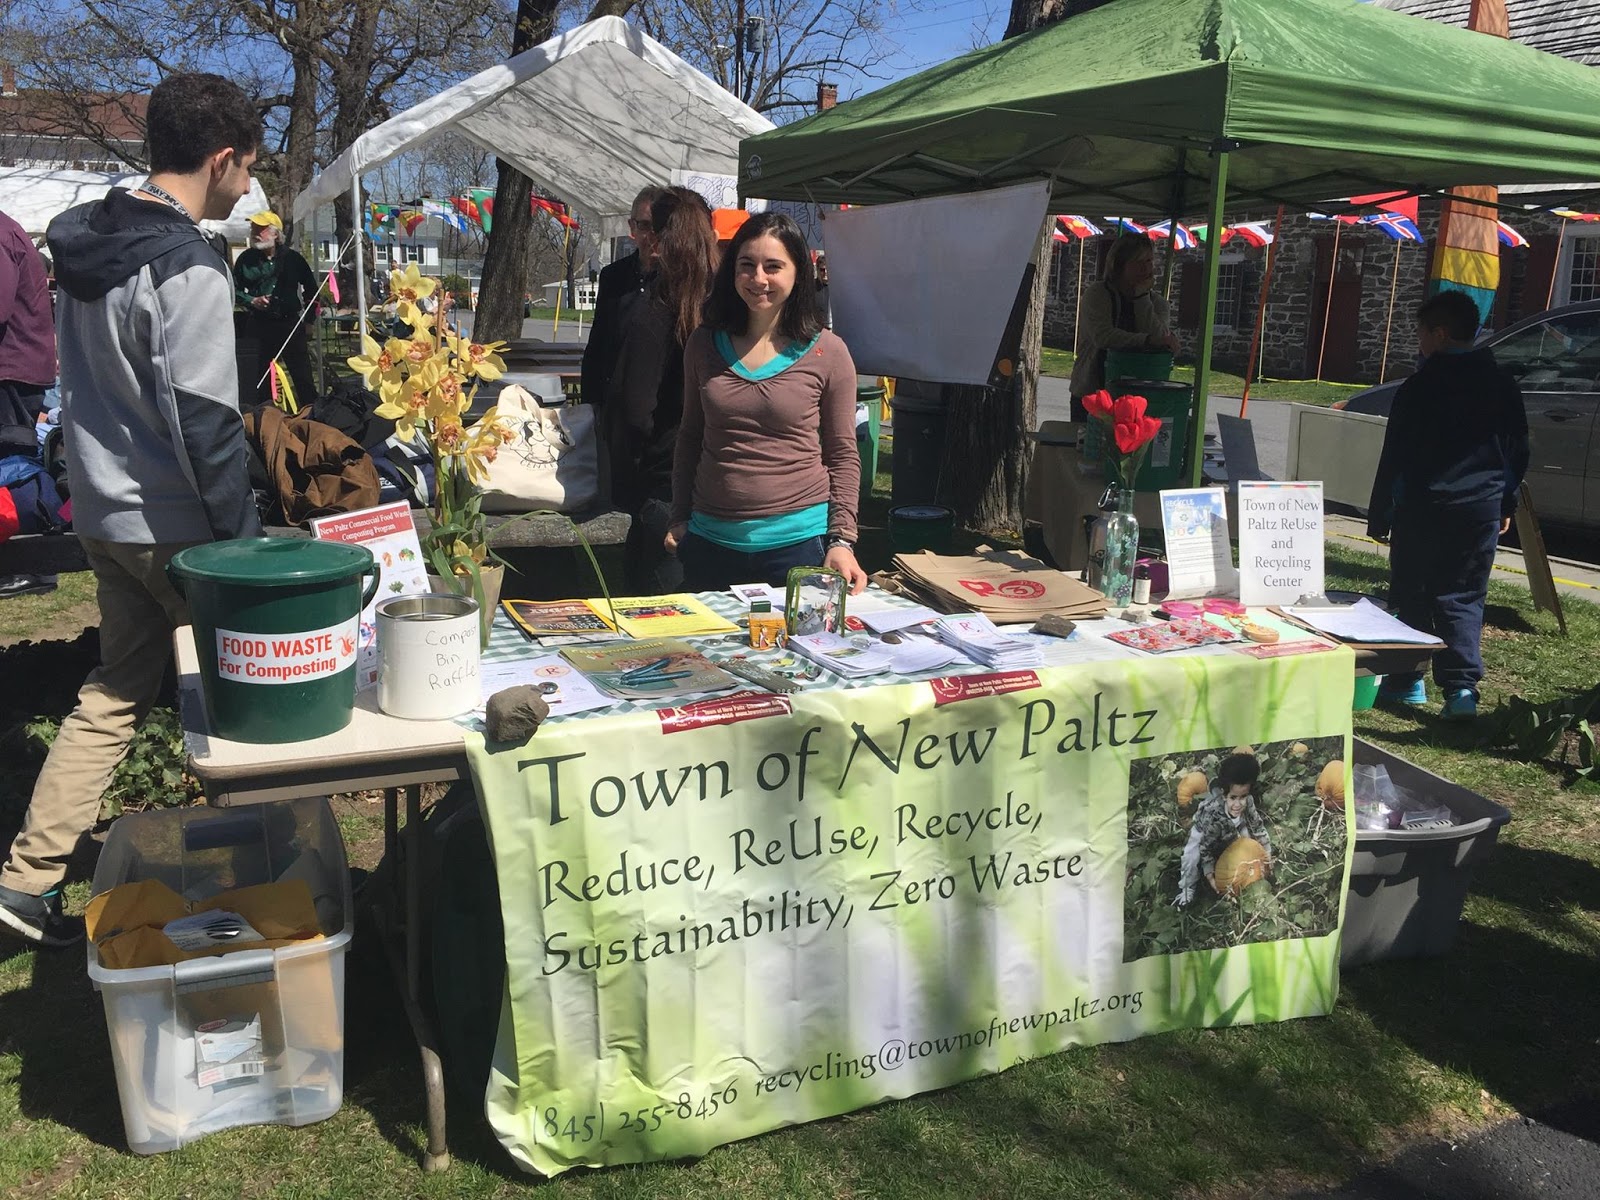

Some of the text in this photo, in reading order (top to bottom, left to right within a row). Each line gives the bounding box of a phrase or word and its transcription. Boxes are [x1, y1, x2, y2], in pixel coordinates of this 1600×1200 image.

[275, 372, 284, 404] CAU
[1243, 498, 1320, 512] Town of New
[320, 527, 336, 537] New
[335, 523, 349, 533] Paltz
[348, 515, 381, 530] Commercial
[380, 512, 394, 523] Food
[342, 523, 396, 541] Composting Program
[1247, 517, 1317, 531] Paltz ReUse
[1271, 537, 1293, 550] and
[1254, 555, 1311, 572] Recycling
[1263, 575, 1303, 588] Center
[222, 633, 333, 658] FOOD WASTE
[219, 657, 241, 675] For
[245, 656, 337, 680] Composting
[436, 653, 460, 667] Bin
[428, 659, 477, 691] Raffle
[517, 692, 1158, 827] Town of New Paltz
[538, 791, 1043, 910] Reduce, ReUse, Recycle,
[541, 851, 1084, 976] Sustainability, Zero Waste
[532, 989, 1144, 1145] (845) 255-8456 recycling@townofnewpaltz.org
